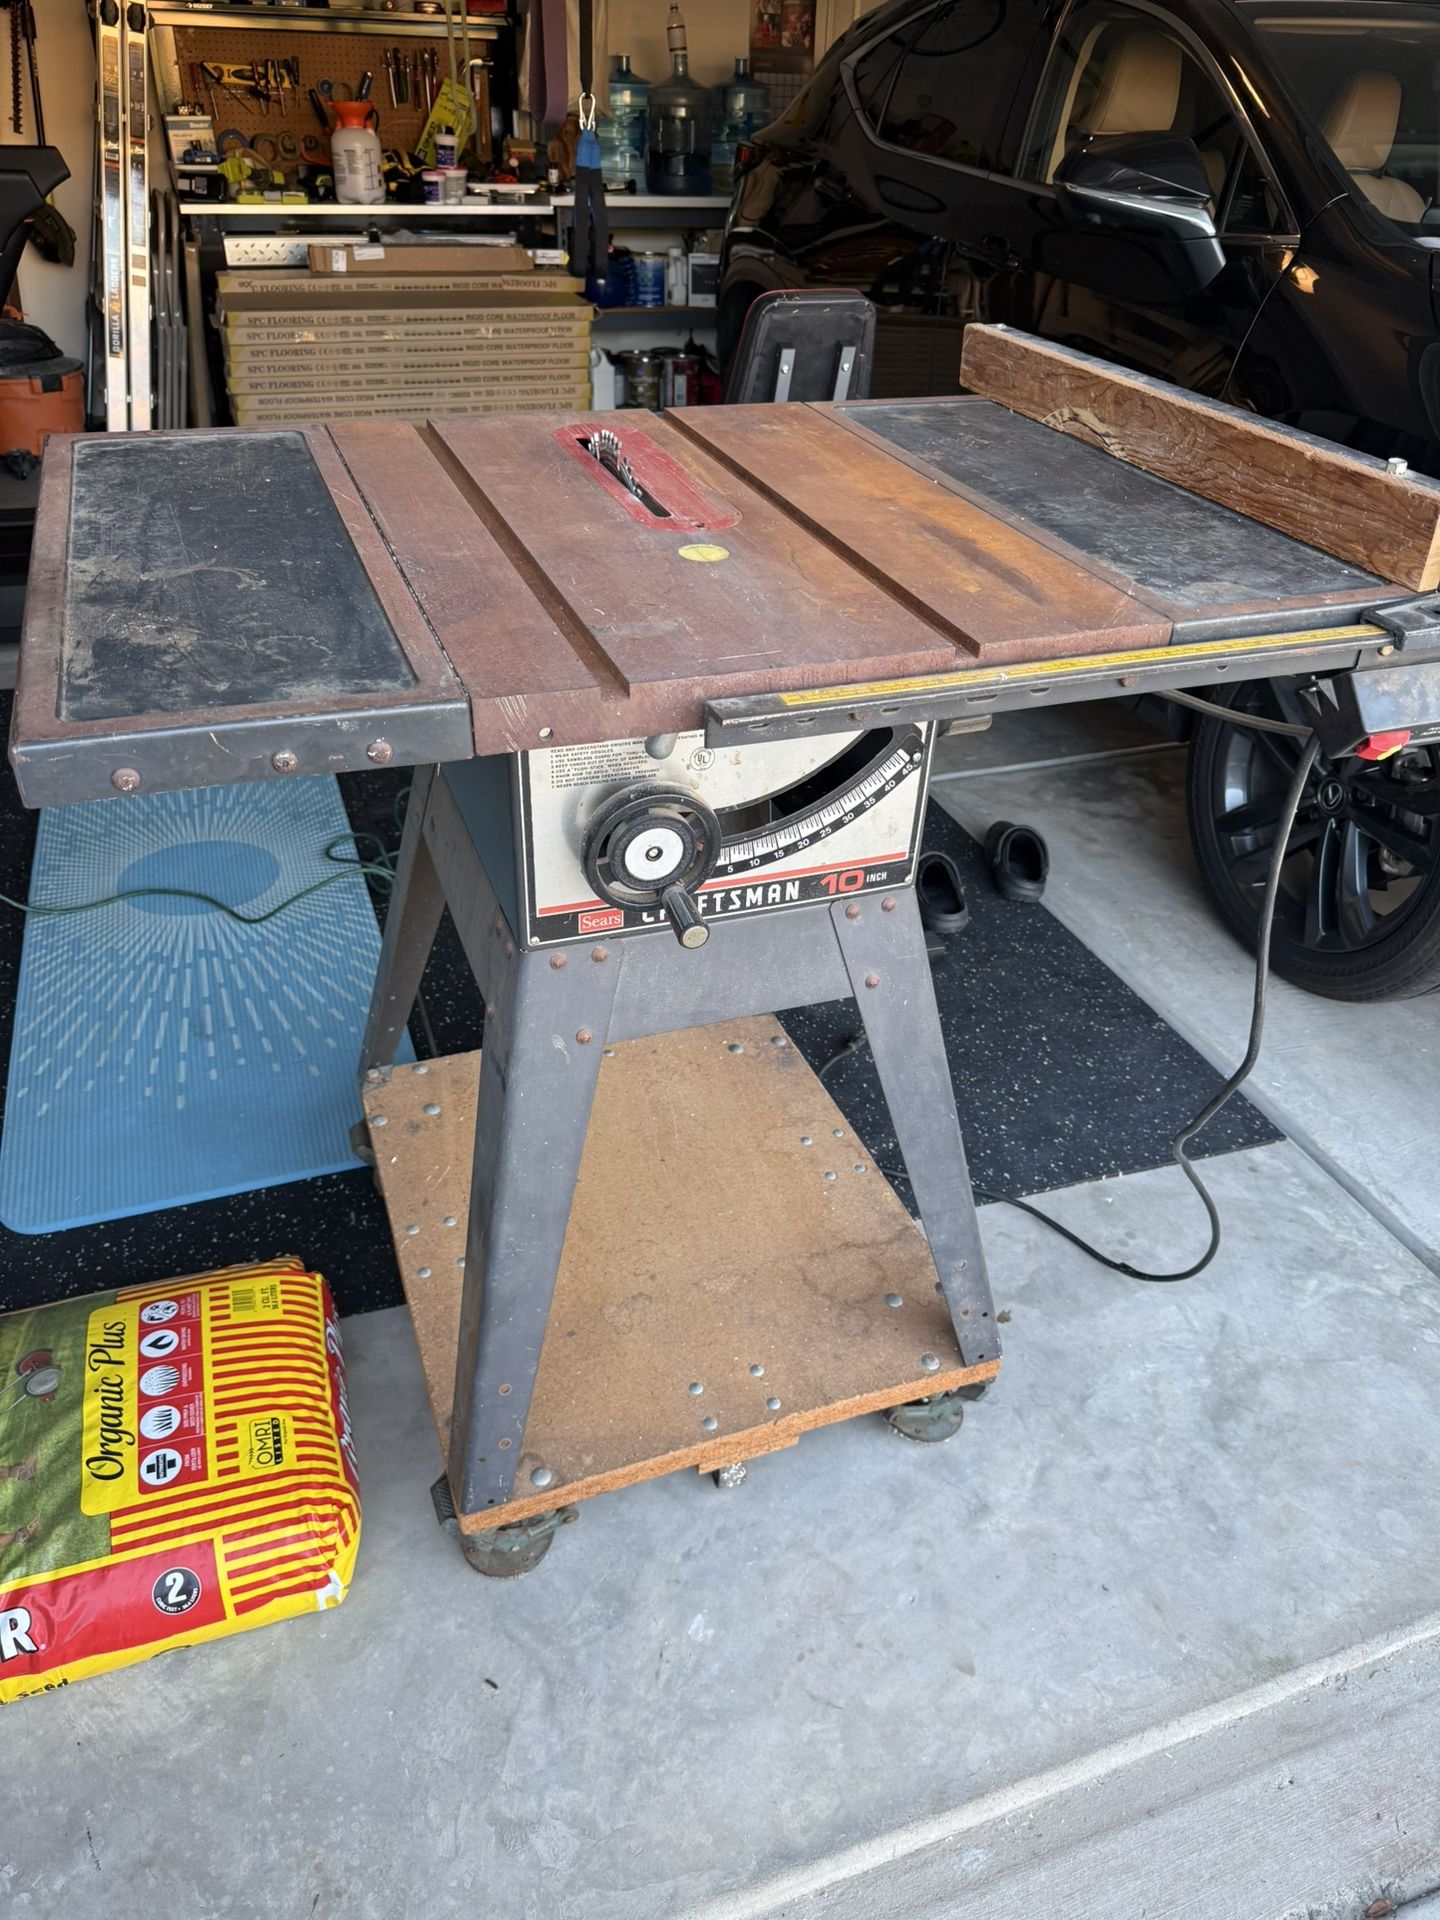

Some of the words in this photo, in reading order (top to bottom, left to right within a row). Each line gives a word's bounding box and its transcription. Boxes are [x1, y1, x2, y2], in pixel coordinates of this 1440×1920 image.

[110, 257, 119, 298] LADDERS
[248, 317, 266, 325] SPC
[268, 316, 314, 324] FLOORING
[112, 315, 120, 352] GORILLA
[270, 348, 316, 357] FLOORING
[248, 366, 266, 374] SPC
[267, 364, 313, 373] FLOORING
[249, 381, 266, 389] SPC
[269, 379, 314, 388] FLOORING
[902, 764, 914, 776] 45
[884, 780, 896, 792] 40
[864, 797, 876, 808] 35
[842, 813, 854, 824] 30
[819, 827, 832, 837] 25
[798, 839, 809, 849] 20
[774, 850, 784, 858] 15
[582, 914, 621, 928] Sears
[820, 870, 864, 895] 10
[866, 872, 887, 882] INCH
[88, 1321, 126, 1372] Plus
[85, 1374, 135, 1480] Organic
[254, 1421, 273, 1465] OMRI
[273, 1420, 282, 1462] LISTED
[166, 1572, 187, 1604] 2
